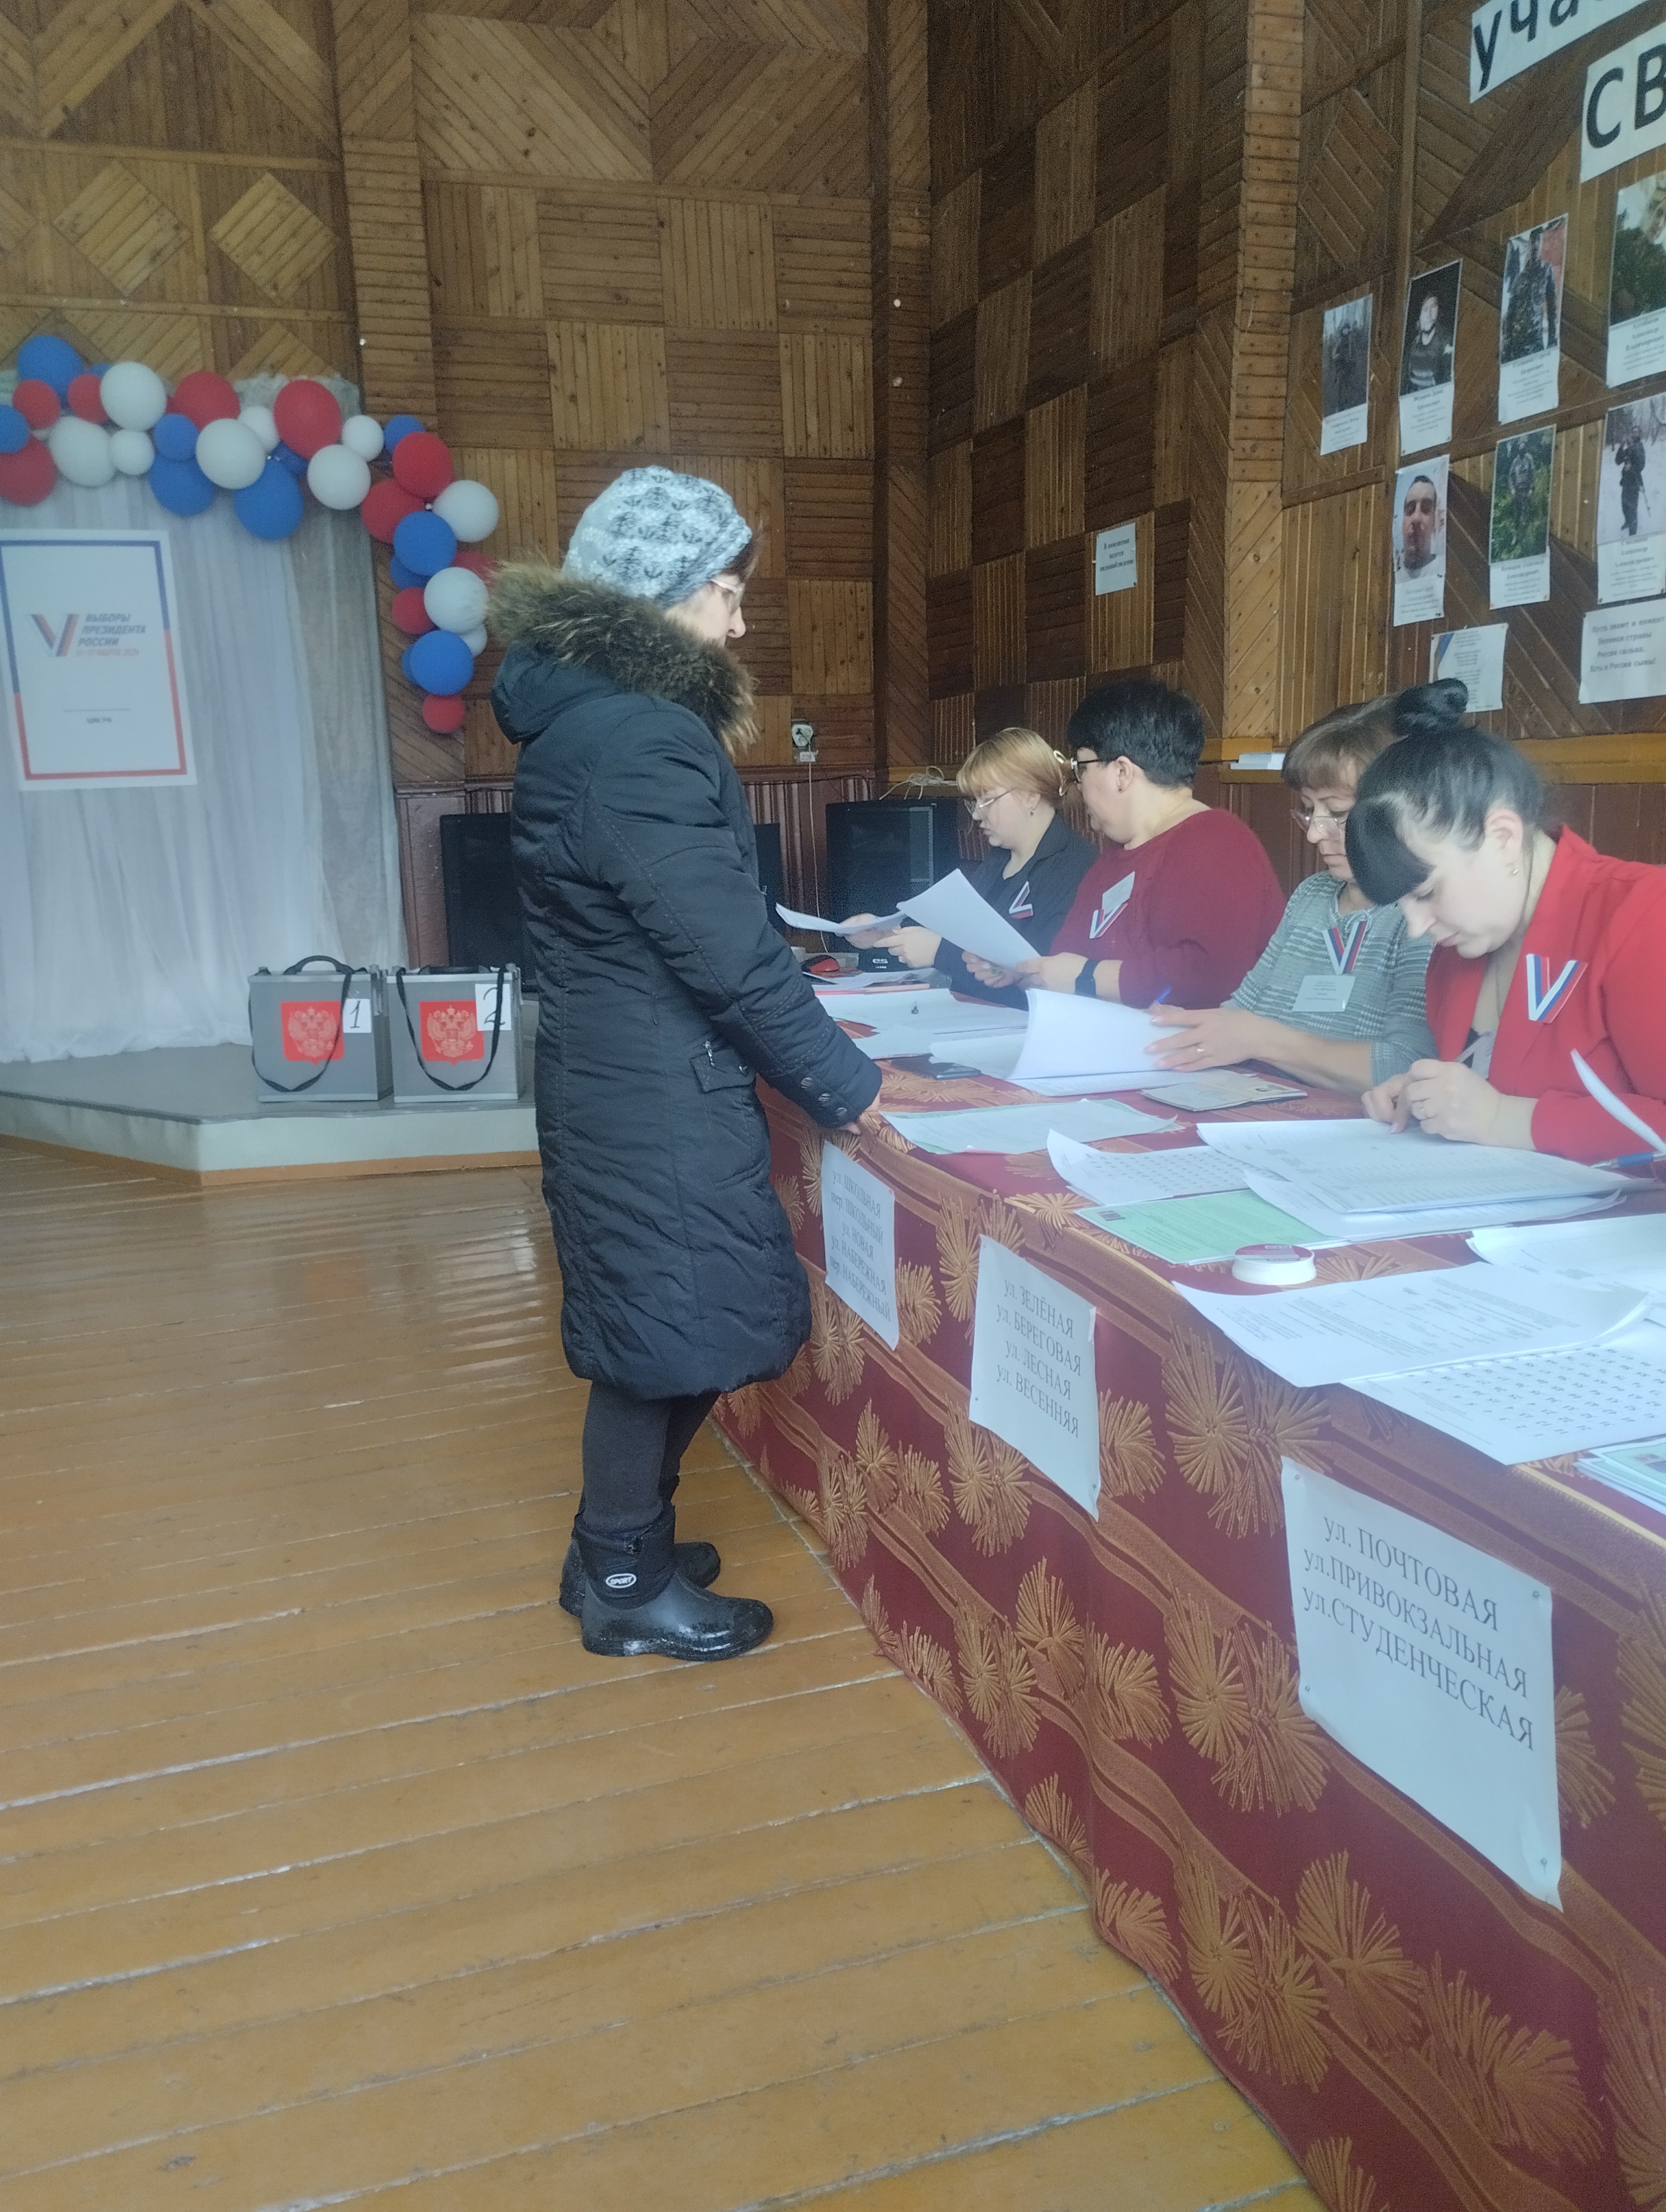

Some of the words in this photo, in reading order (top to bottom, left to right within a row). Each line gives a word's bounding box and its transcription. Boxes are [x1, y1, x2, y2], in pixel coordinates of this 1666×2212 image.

[78, 637, 119, 647] РОССИИ
[81, 625, 146, 635] ПРЕЗИДЕНТА
[86, 613, 132, 623] ВЫБОРЫ
[350, 1000, 361, 1029] 1
[844, 1174, 881, 1220] ШКОЛЬНАЯ
[845, 1198, 883, 1247] ШКОЛЬНЫЙ
[842, 1240, 887, 1296] НАБЕРЕЖНАЯ
[851, 1226, 874, 1262] НОВАЯ
[842, 1264, 891, 1322] НАБЕРЕЖНЫЙ
[1004, 1279, 1017, 1301] ул.
[1020, 1285, 1074, 1339] ЗЕЛЁНАЯ
[996, 1304, 1011, 1326] ул.
[1014, 1311, 1082, 1377] БЕРЕГОВАЯ
[1005, 1340, 1021, 1361] ул.
[1023, 1348, 1072, 1401] ЛЕСНАЯ
[996, 1365, 1012, 1386] ул.
[1015, 1371, 1079, 1439] ВЕСЕННЯЯ
[1323, 1516, 1352, 1548] ул.
[1357, 1527, 1500, 1632] ПОЧТОВАЯ
